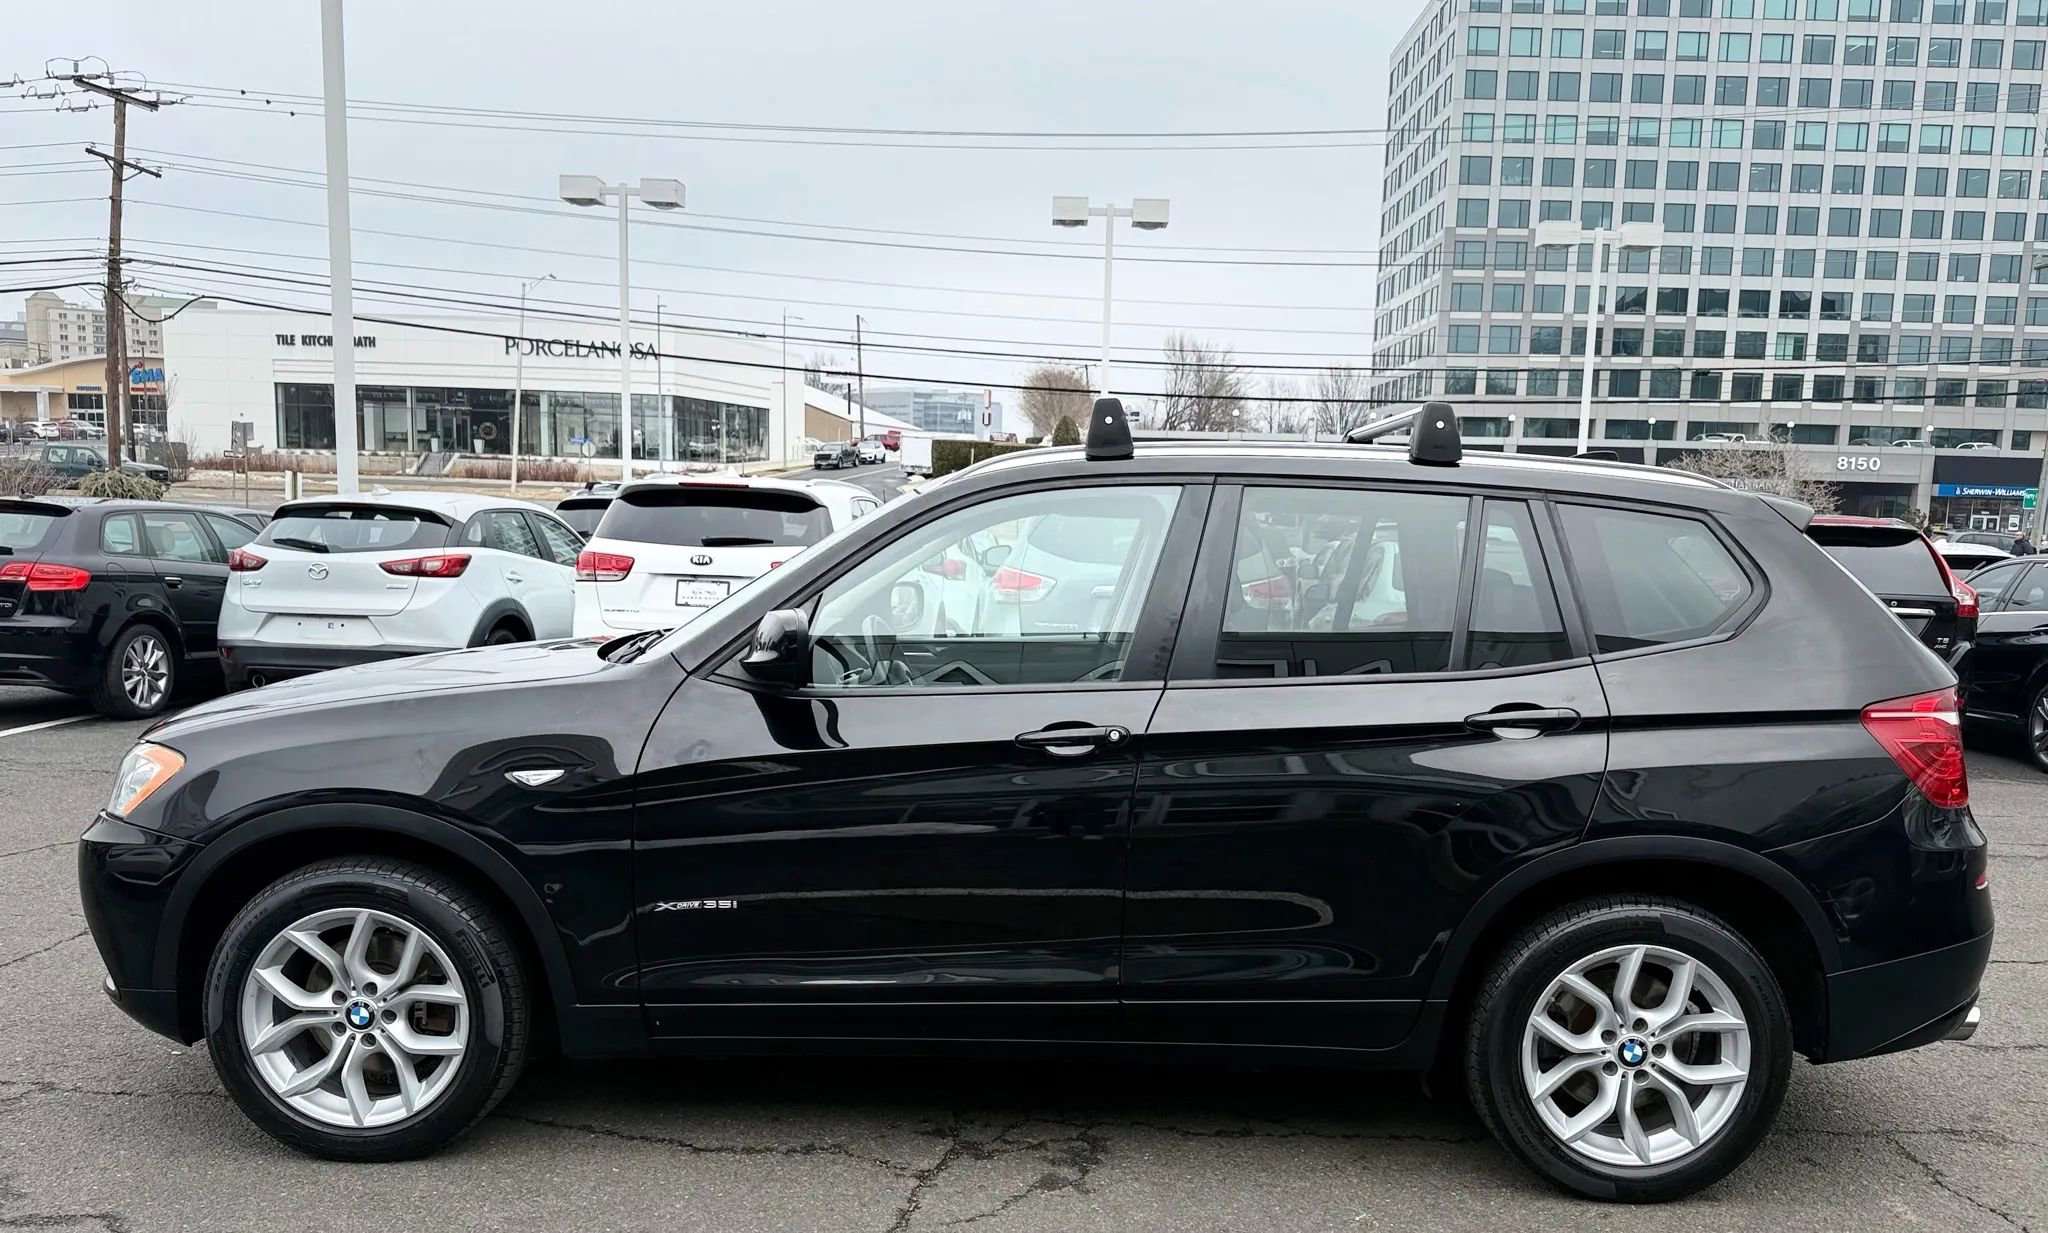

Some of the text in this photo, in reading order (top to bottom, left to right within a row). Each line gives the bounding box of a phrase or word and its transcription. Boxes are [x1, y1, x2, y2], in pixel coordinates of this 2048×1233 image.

[275, 334, 296, 346] TILE
[301, 335, 333, 347] KITCH
[1836, 456, 1881, 471] 8150
[692, 555, 711, 565] KIA
